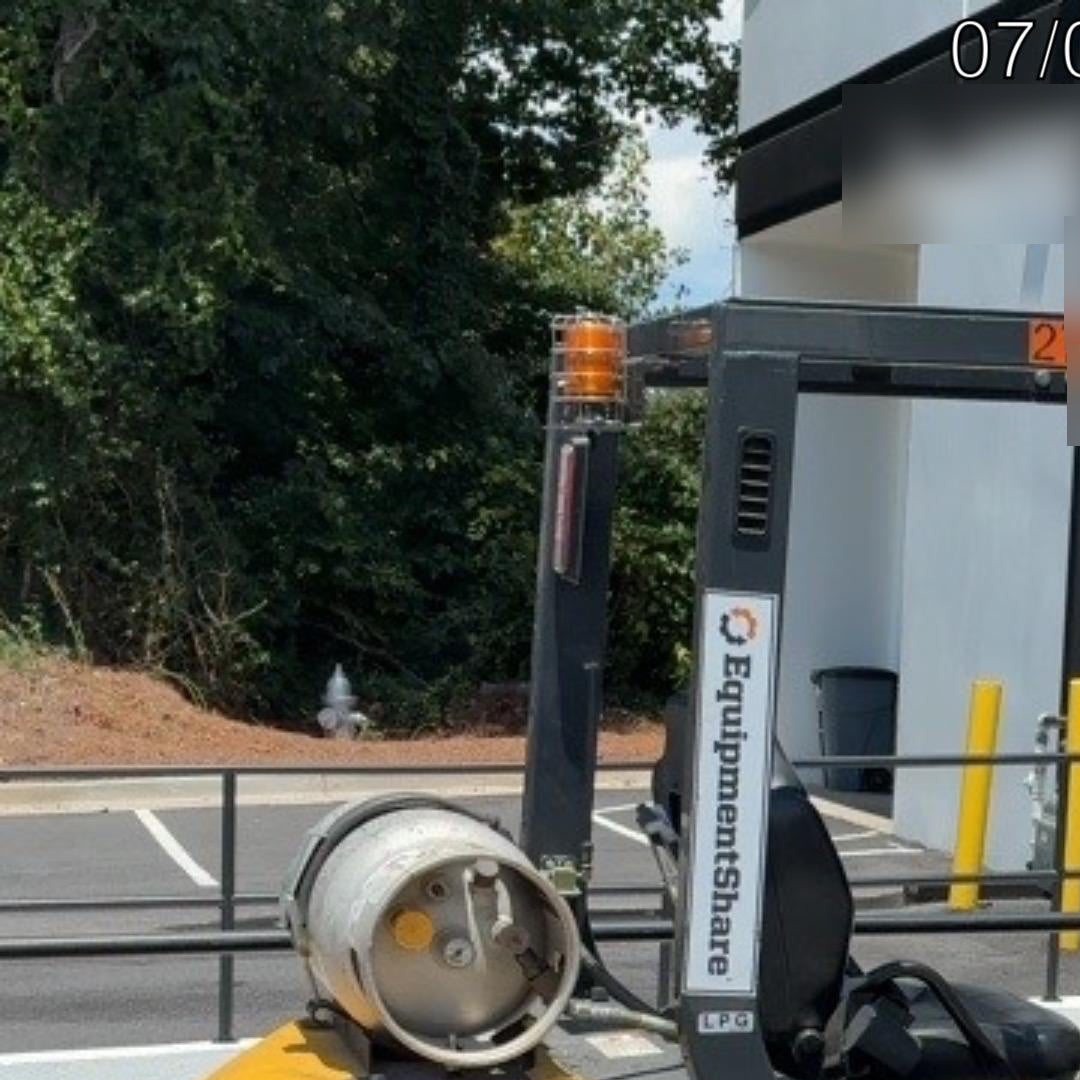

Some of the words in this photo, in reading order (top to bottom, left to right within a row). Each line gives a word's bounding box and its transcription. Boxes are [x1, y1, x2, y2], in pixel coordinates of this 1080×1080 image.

[1034, 322, 1065, 361] 2
[706, 653, 751, 977] EquipmentShare
[703, 1012, 748, 1029] LPG
